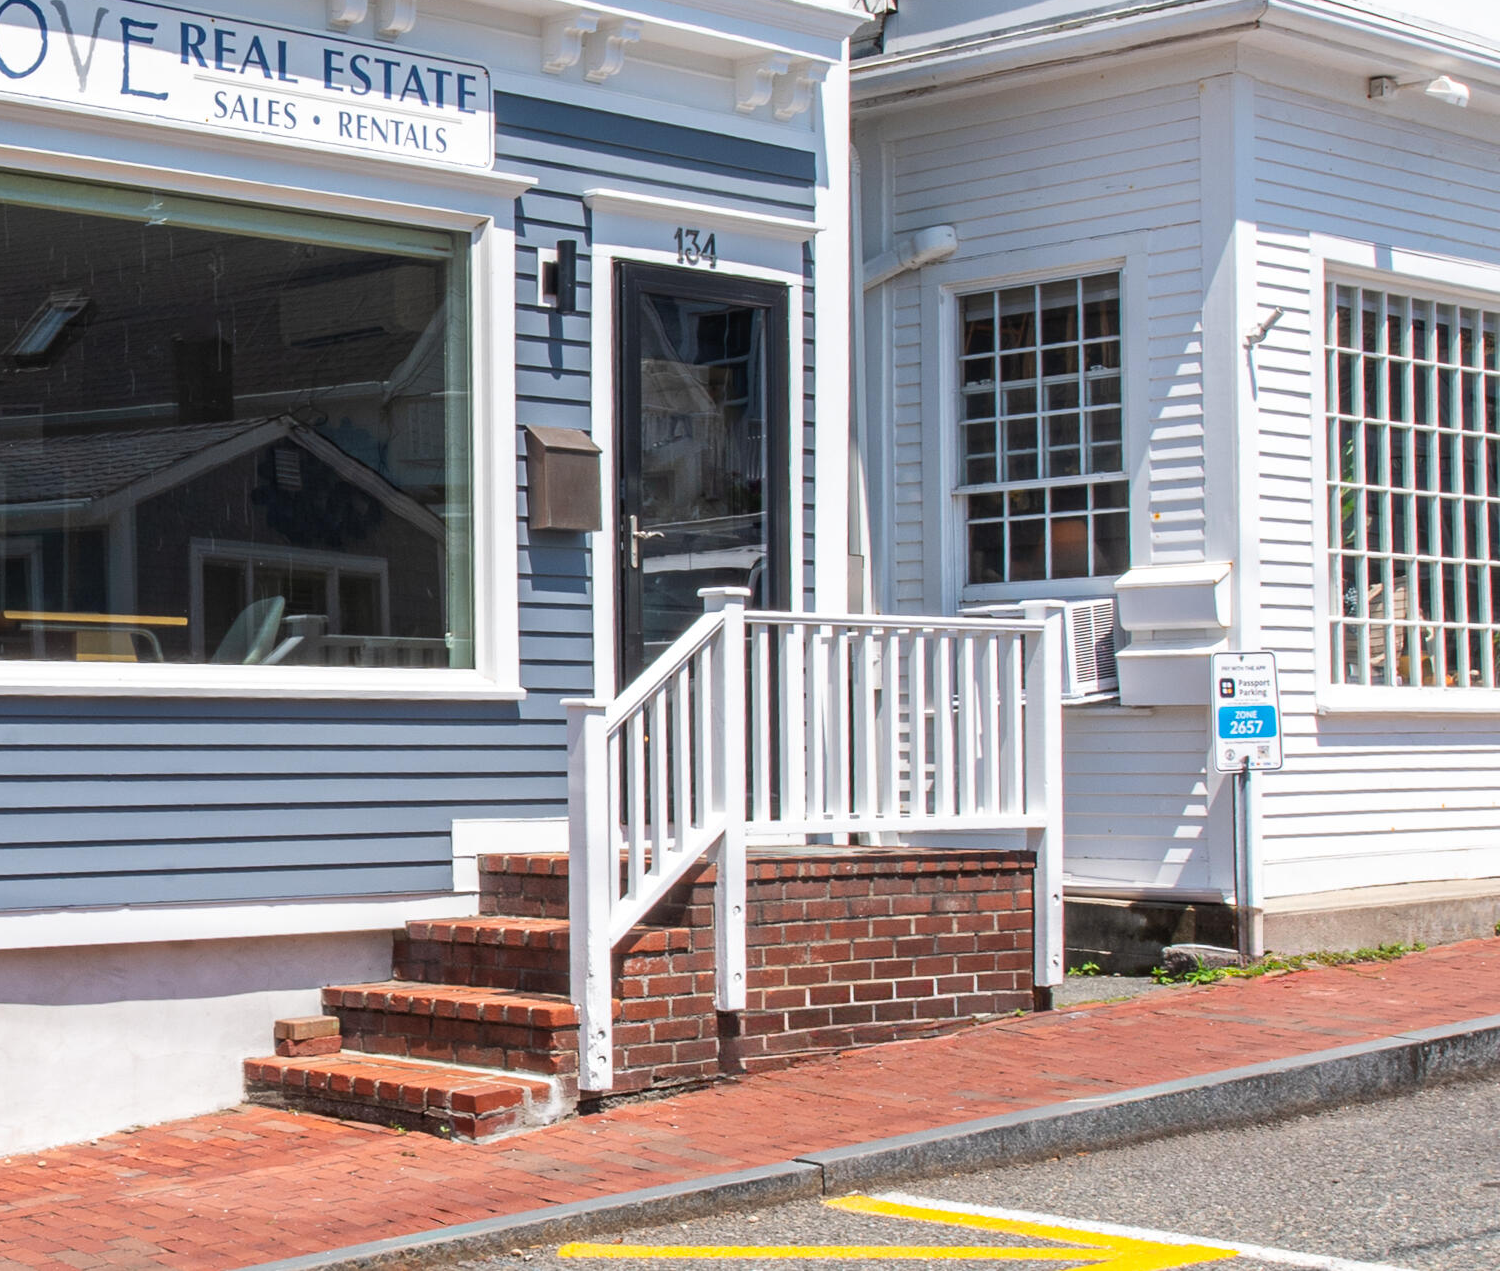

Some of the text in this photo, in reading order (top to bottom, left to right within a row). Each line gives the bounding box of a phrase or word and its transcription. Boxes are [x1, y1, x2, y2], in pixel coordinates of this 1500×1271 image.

[179, 22, 477, 115] REAL ESTATE
[213, 90, 448, 154] SALES RENTALS
[673, 227, 717, 269] 134
[1238, 679, 1270, 687] Passport
[1239, 689, 1268, 698] Parking
[1235, 710, 1258, 720] ZONE
[1230, 720, 1264, 735] 2657
